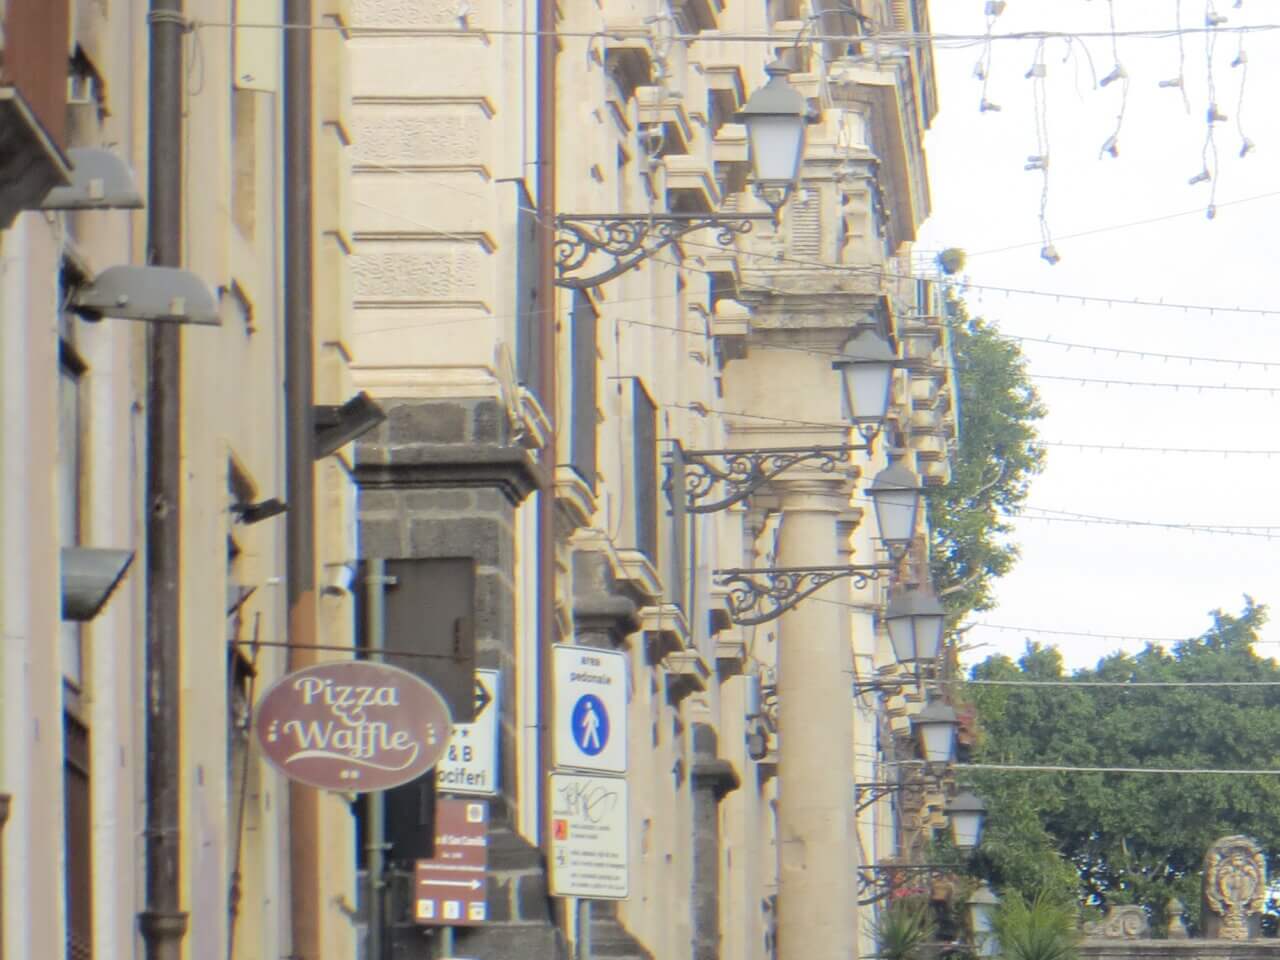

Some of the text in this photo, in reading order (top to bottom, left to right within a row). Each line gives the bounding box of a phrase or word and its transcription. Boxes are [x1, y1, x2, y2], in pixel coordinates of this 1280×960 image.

[294, 677, 400, 706] Pizza
[283, 720, 417, 764] Waffle
[463, 745, 472, 762] B
[437, 767, 485, 785] ociferi
